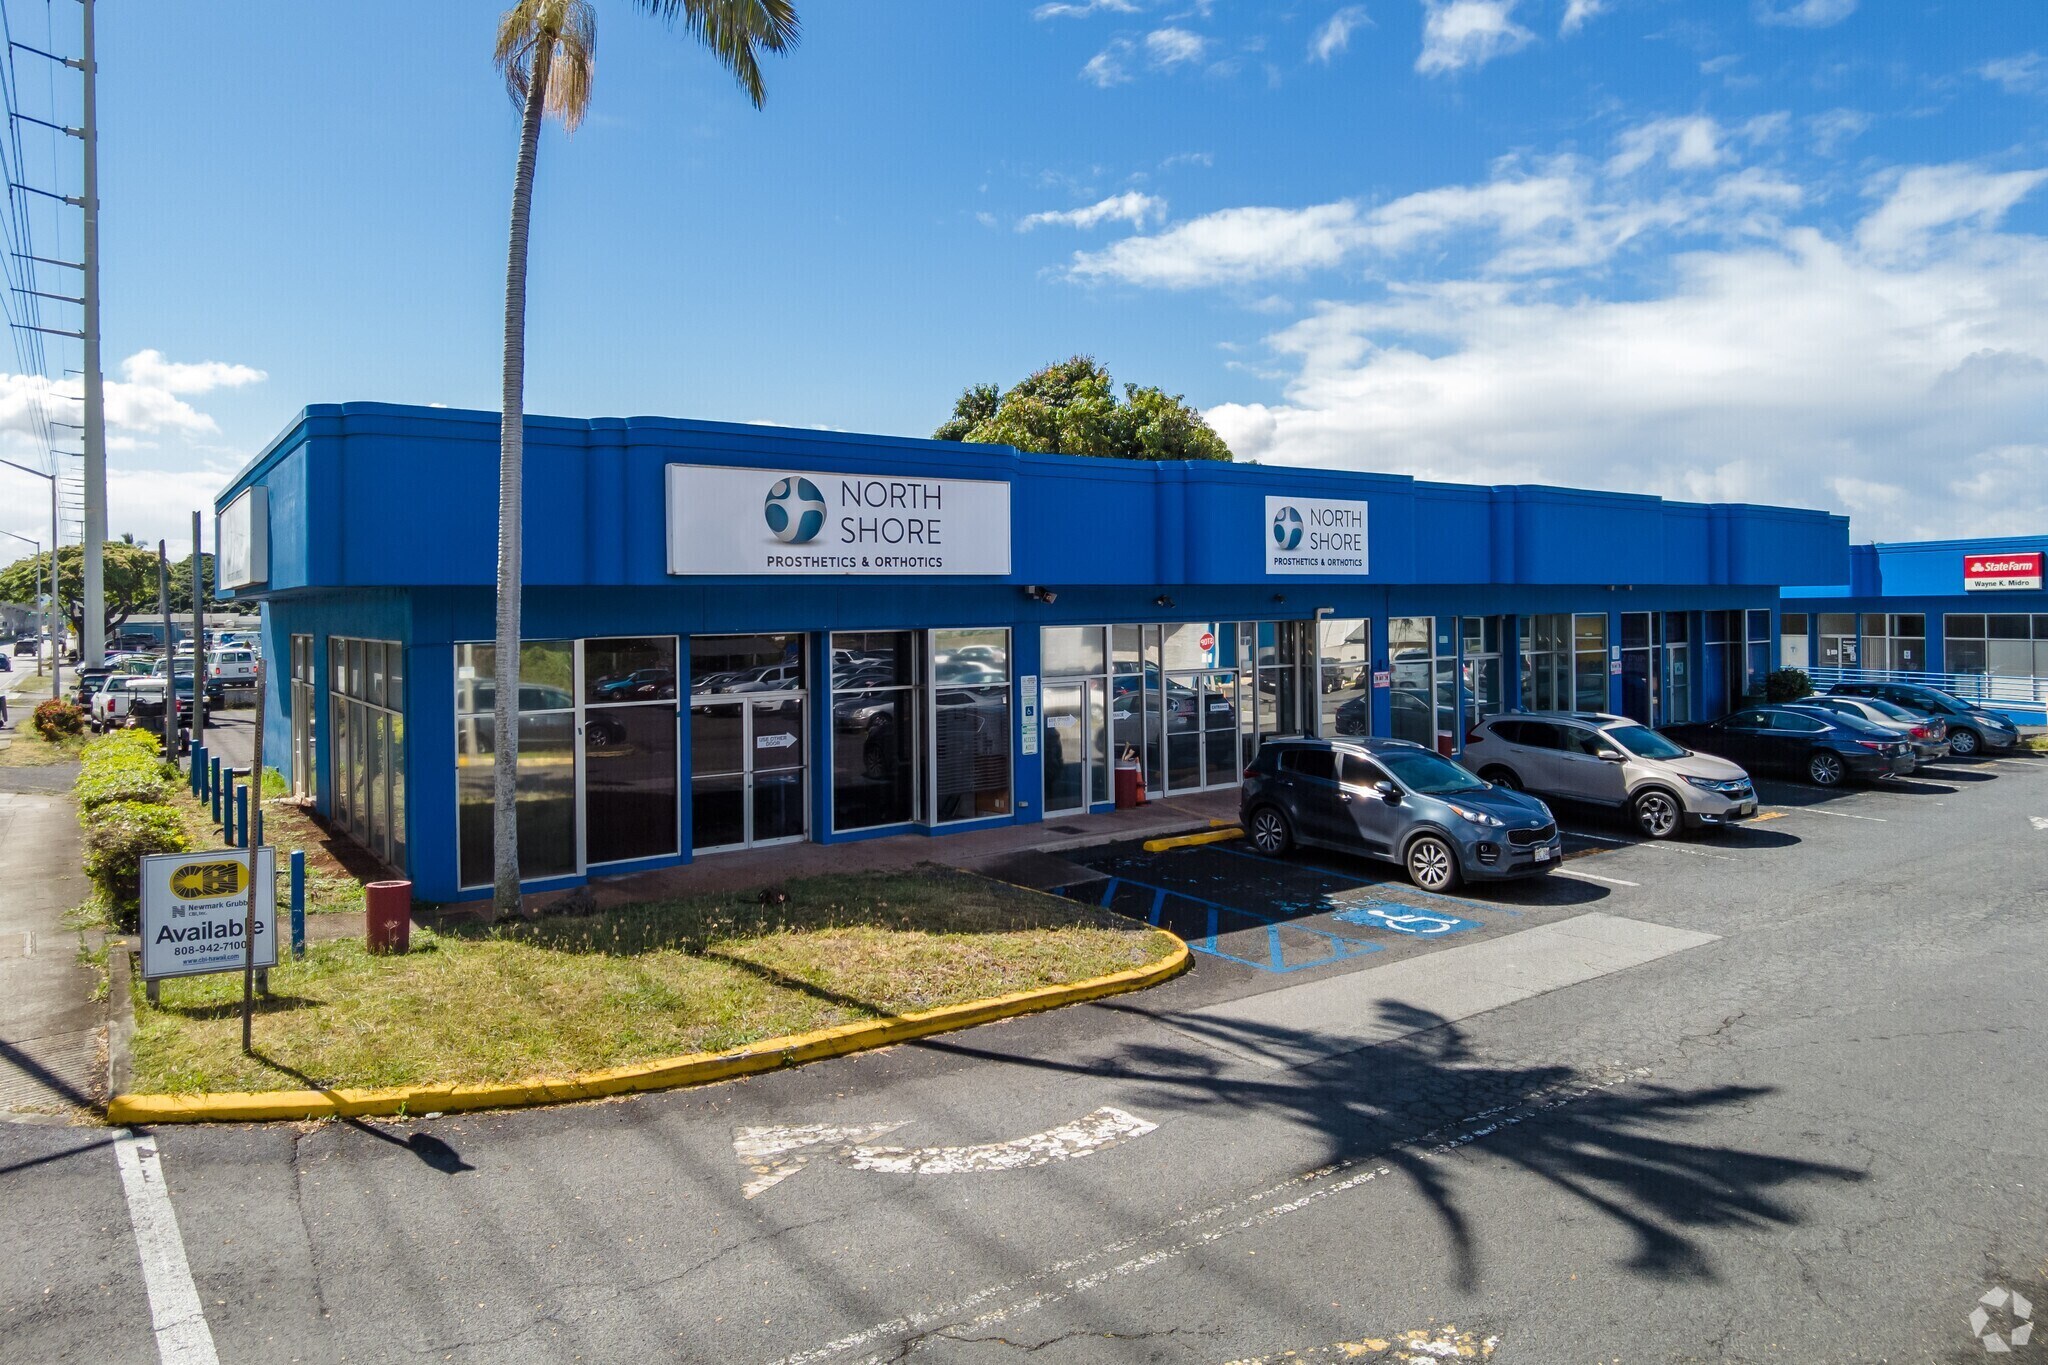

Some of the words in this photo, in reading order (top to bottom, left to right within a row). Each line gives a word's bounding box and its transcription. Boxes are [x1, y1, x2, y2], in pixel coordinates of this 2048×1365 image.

[842, 480, 942, 510] NORTH
[1310, 507, 1362, 529] NORTH
[841, 516, 942, 545] SHORE
[1310, 532, 1362, 551] SHORE
[767, 555, 857, 568] PROSTHETICS
[861, 556, 870, 568] &
[874, 556, 943, 568] ORTHOTICS
[1274, 557, 1319, 566] PROSTHETICS
[1321, 558, 1326, 566] &
[1327, 558, 1363, 567] ORTHOTICS
[1974, 580, 1997, 588] Wayne
[173, 863, 239, 899] CBI
[188, 902, 224, 911] Newmark
[226, 900, 249, 908] Grubb
[155, 918, 265, 944] Available
[174, 940, 247, 956] 808-942-7100
